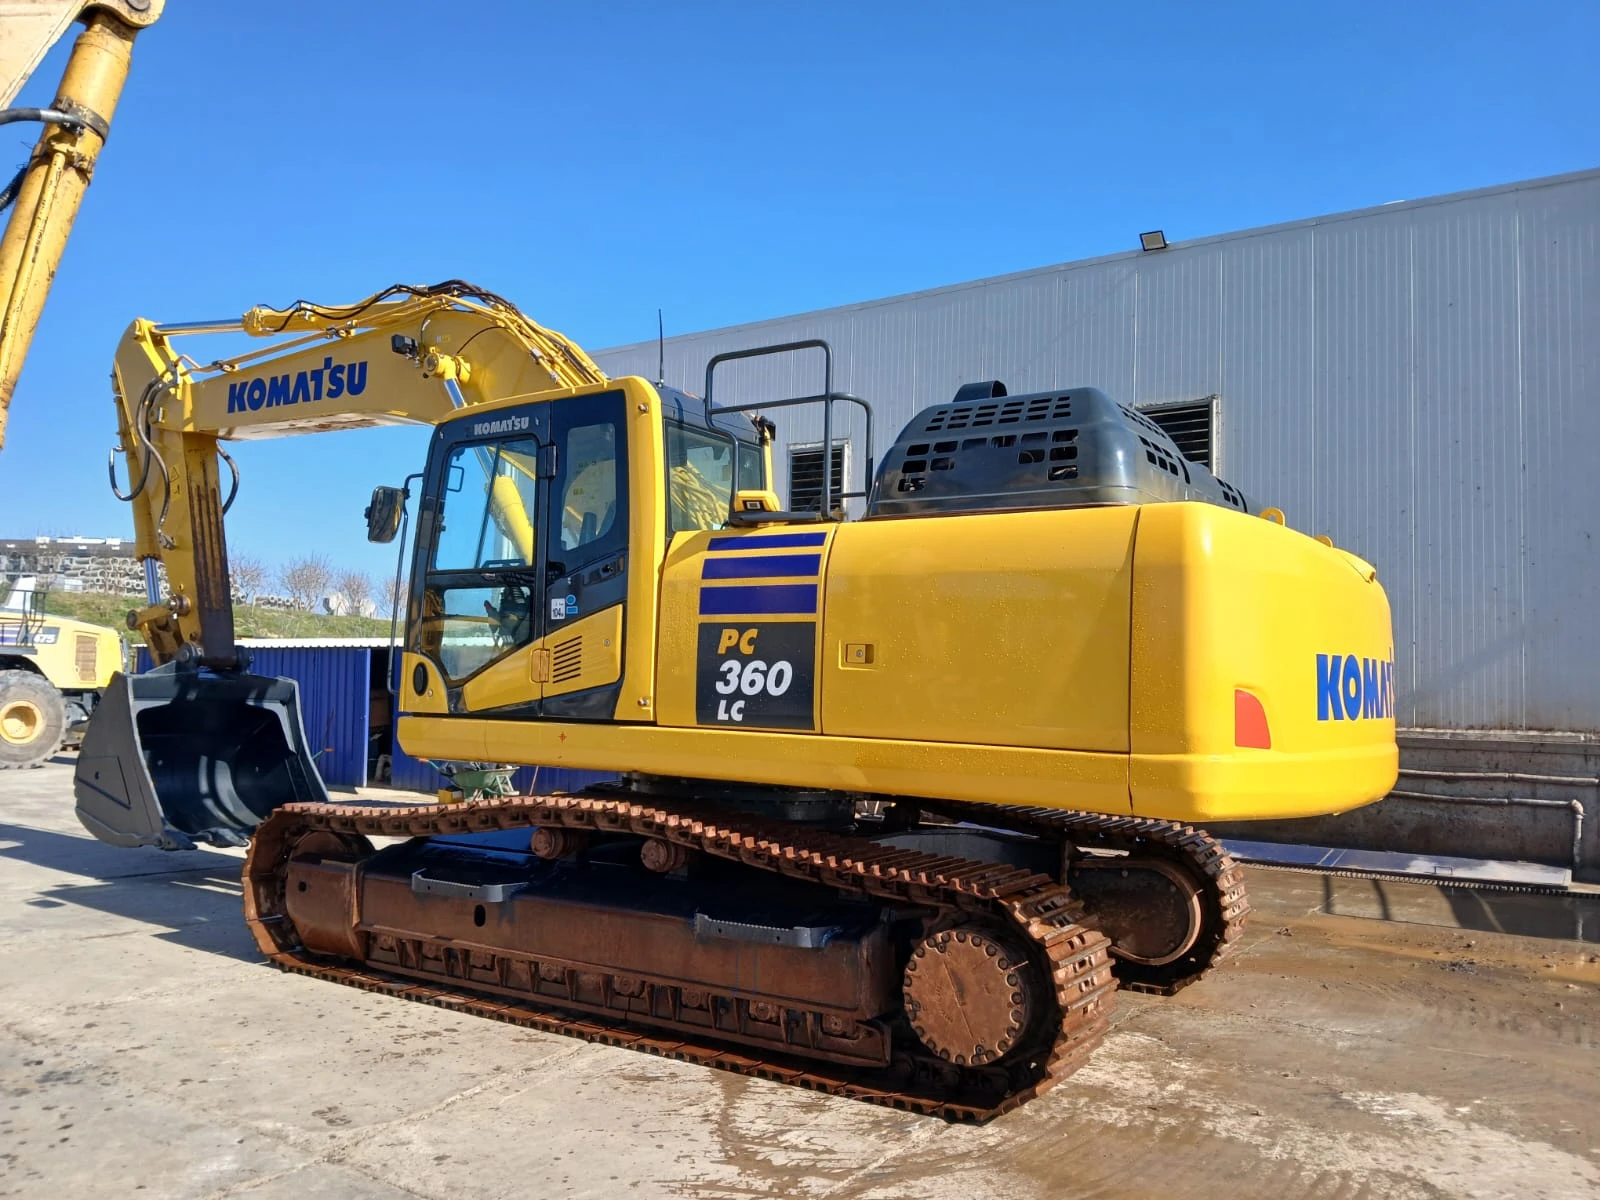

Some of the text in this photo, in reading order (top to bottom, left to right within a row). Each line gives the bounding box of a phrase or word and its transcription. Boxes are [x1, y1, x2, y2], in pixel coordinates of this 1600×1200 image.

[228, 357, 368, 414] KOMATSU
[474, 416, 530, 436] KOMATSU
[717, 628, 759, 655] PC
[715, 659, 793, 697] 360
[717, 699, 746, 722] LC
